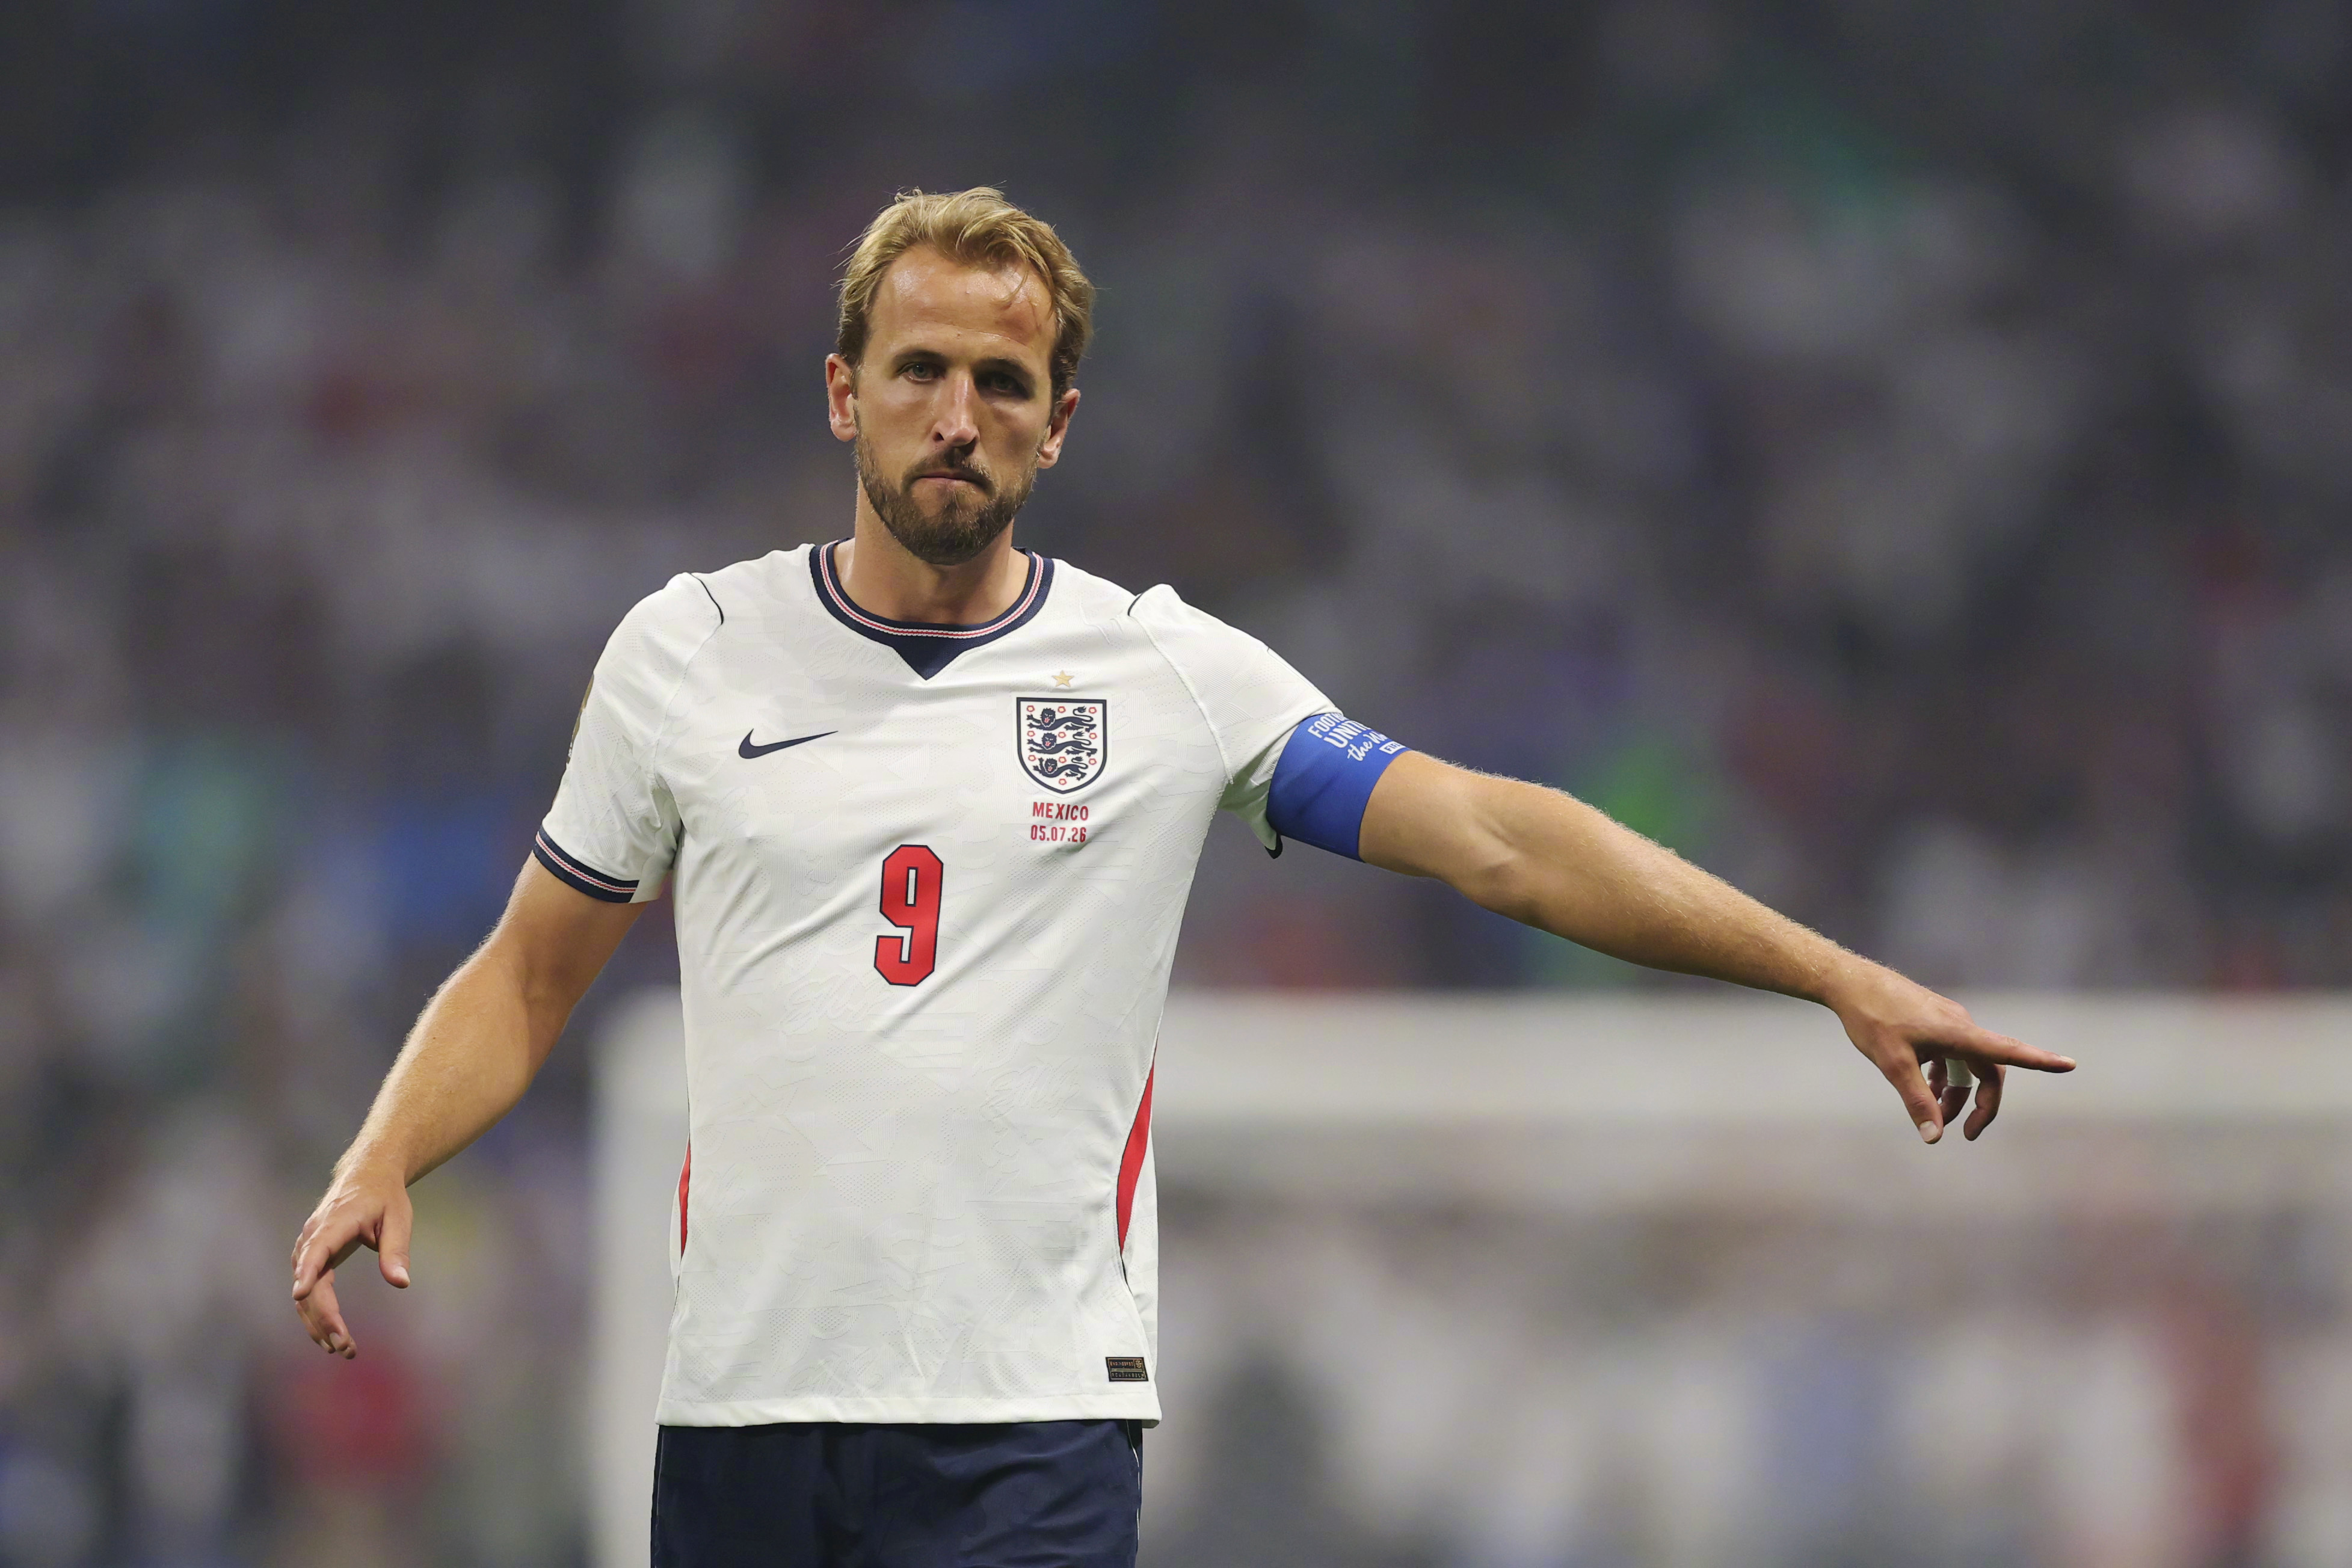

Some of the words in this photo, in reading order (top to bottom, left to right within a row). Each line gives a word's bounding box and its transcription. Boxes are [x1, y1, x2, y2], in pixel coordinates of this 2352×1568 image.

[1307, 713, 1349, 739] FOOTB
[1347, 743, 1373, 761] the
[1362, 730, 1388, 743] W
[1032, 801, 1089, 820] MEXICO
[1030, 825, 1087, 842] 05.07.26
[874, 844, 943, 986] 9
